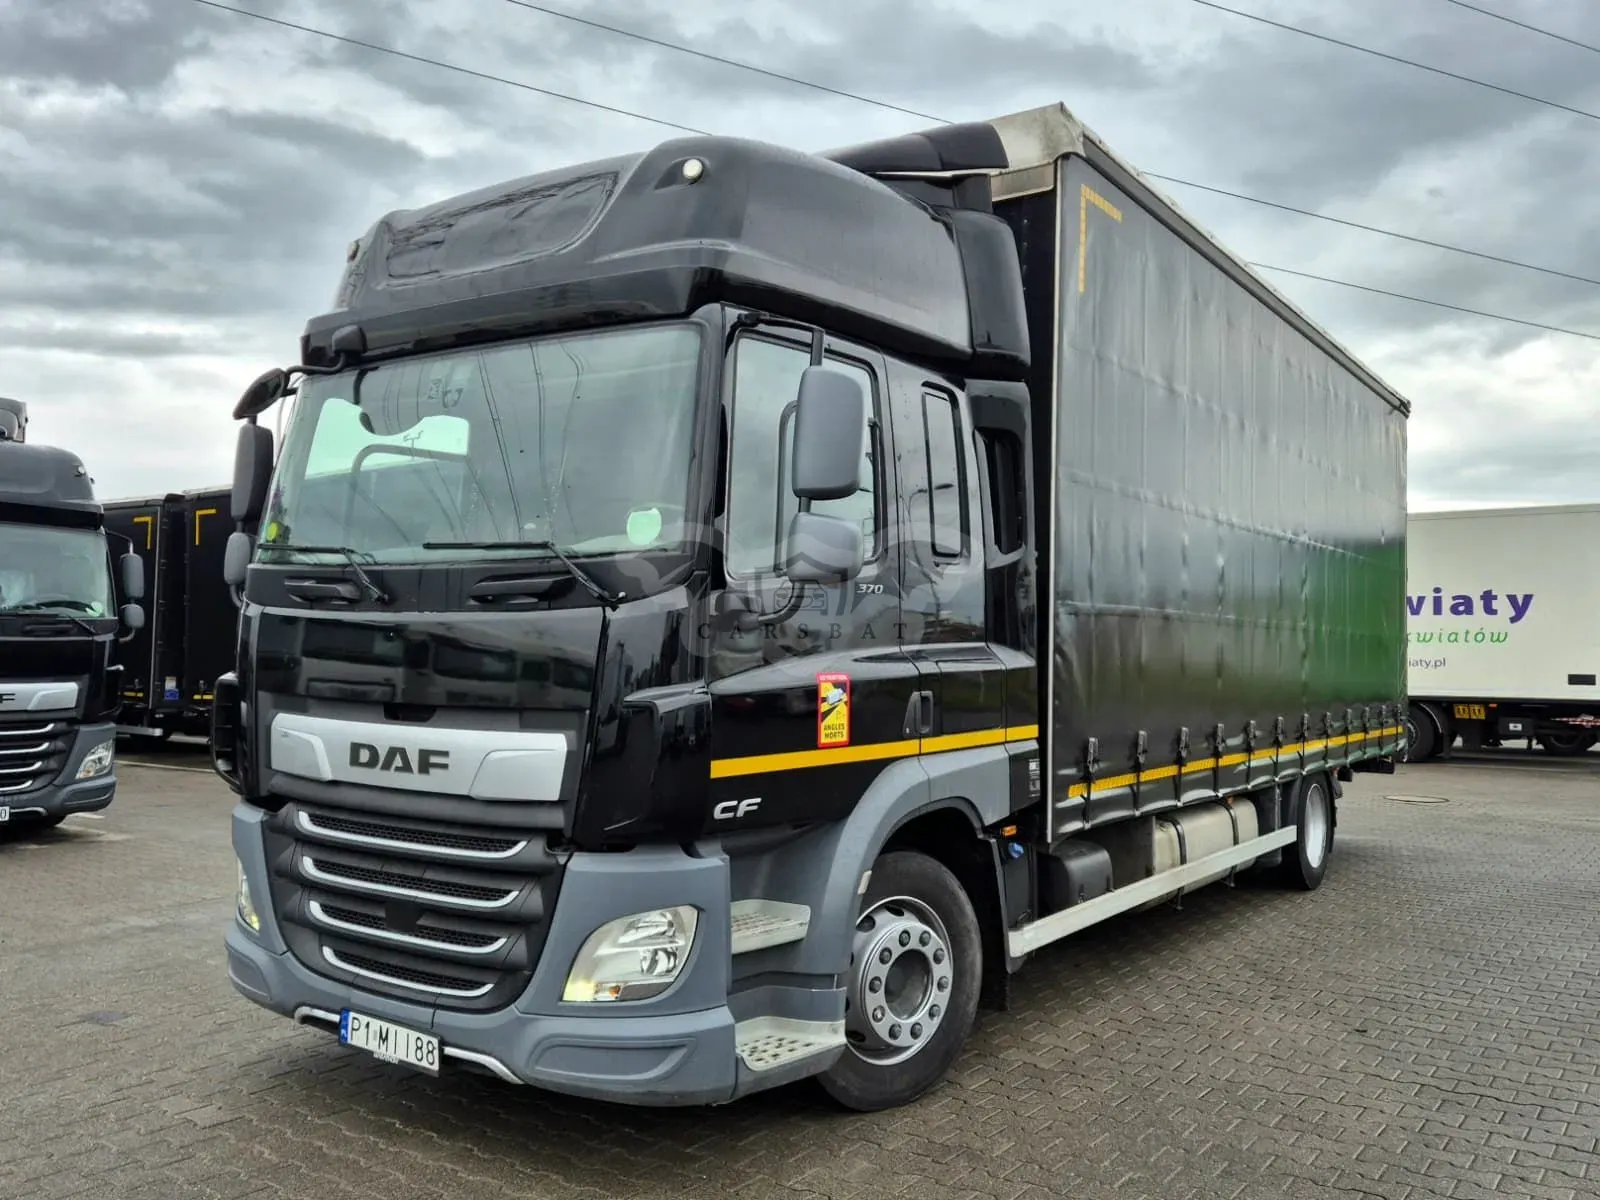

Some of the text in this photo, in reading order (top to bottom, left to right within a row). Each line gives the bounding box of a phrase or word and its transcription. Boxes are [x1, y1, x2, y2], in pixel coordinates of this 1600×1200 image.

[856, 583, 884, 594] 370
[349, 741, 450, 775] DAF
[713, 797, 762, 820] CF
